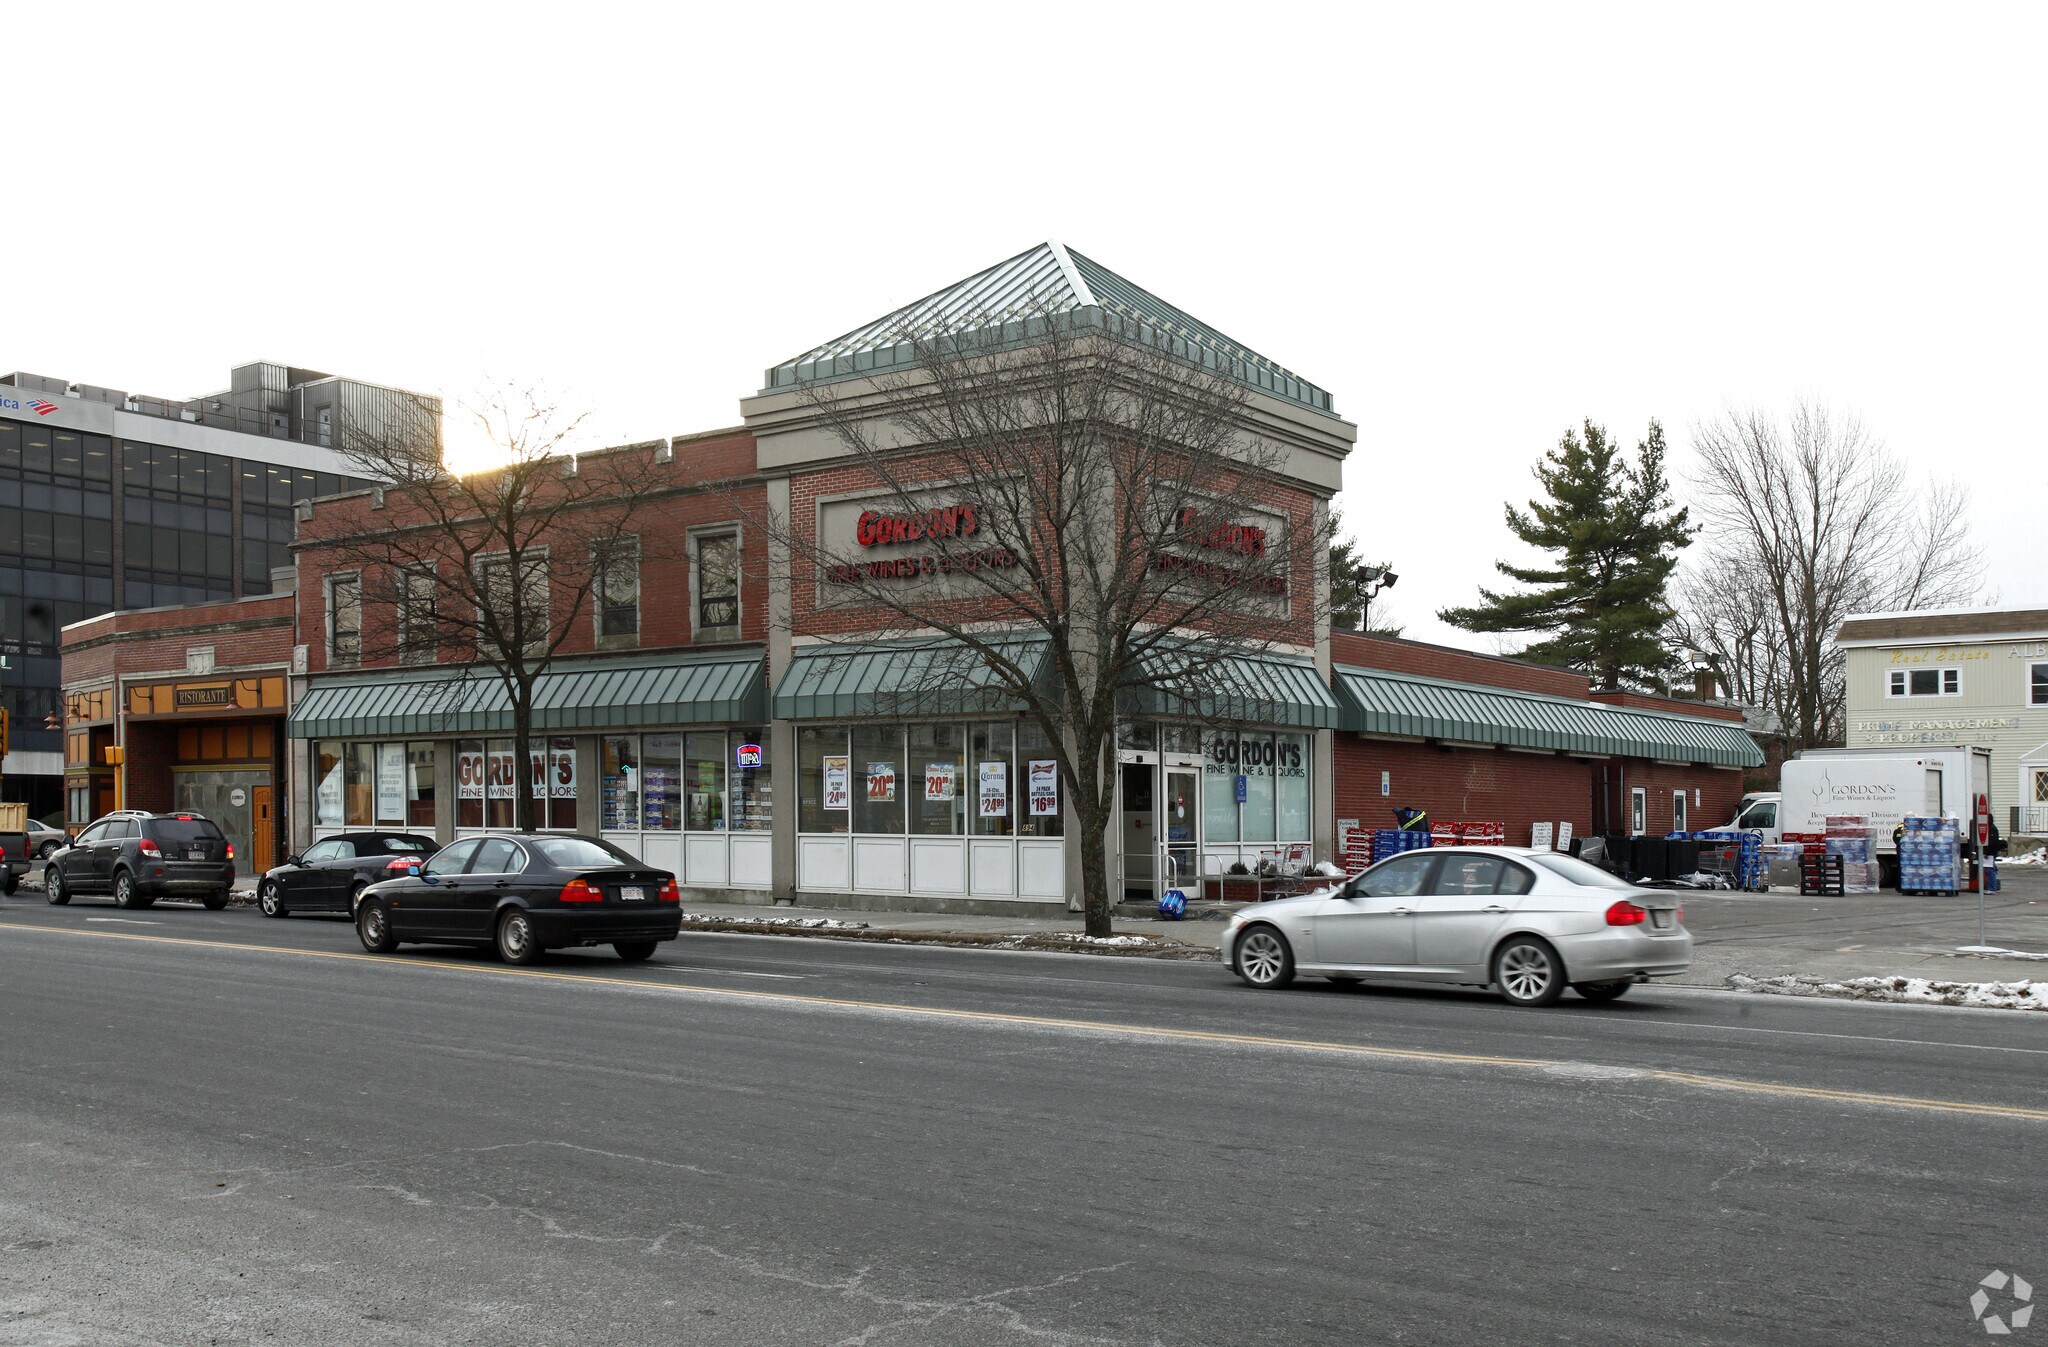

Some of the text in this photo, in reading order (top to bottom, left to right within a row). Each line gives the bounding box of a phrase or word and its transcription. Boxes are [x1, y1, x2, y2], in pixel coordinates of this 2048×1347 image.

[857, 503, 977, 547] GORDON'S
[1935, 646, 1991, 662] Estate
[179, 689, 226, 704] RISTORANTE
[1214, 738, 1301, 768] GORDON'S
[459, 753, 573, 787] GORDN'S
[981, 772, 1005, 782] Corona
[1206, 763, 1226, 774] FINE
[1257, 767, 1265, 776] &
[461, 787, 483, 797] FINE
[1831, 783, 1896, 795] GORDON'S
